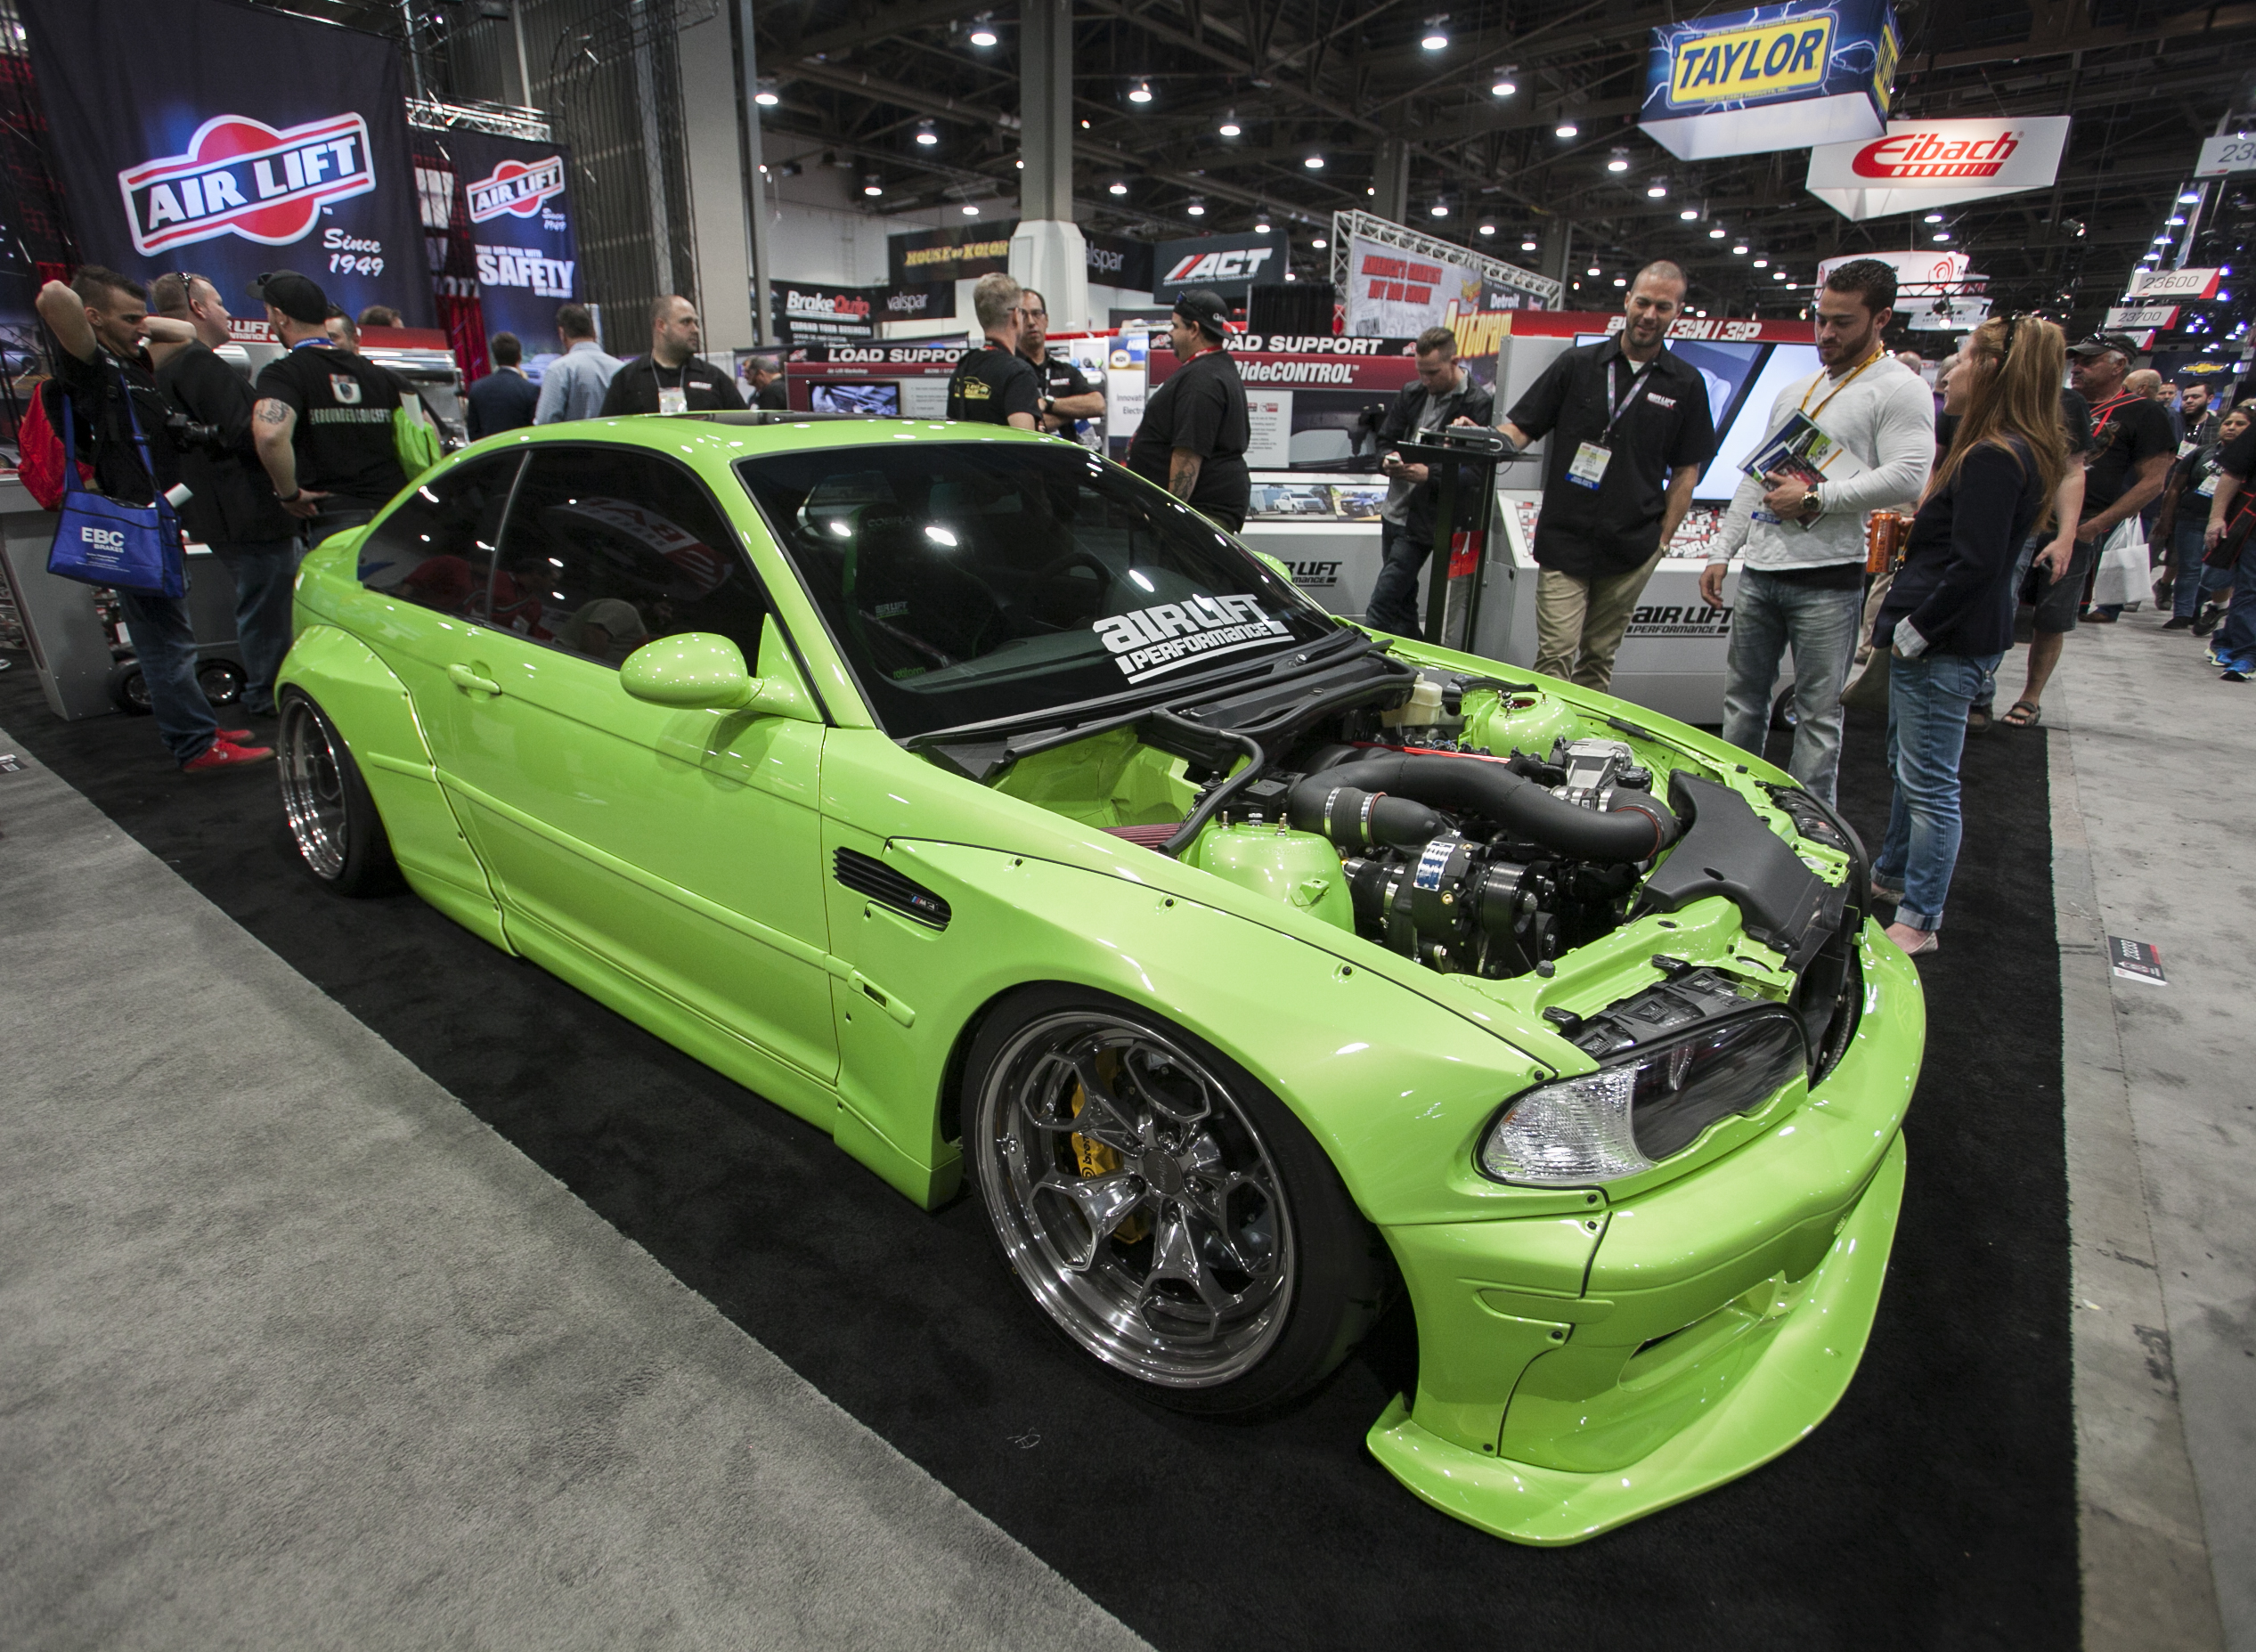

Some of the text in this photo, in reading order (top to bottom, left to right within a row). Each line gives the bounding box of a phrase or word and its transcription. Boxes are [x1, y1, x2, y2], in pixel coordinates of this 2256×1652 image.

[1680, 28, 1824, 88] TAYLOR
[1852, 132, 2018, 178] Eibach
[2218, 142, 2256, 163] 23
[149, 136, 356, 230] AIR LIFT
[476, 167, 558, 212] AIR LIFT
[323, 228, 381, 253] Since
[329, 254, 384, 277] 1949
[904, 246, 951, 266] HOUSE
[1086, 240, 1124, 273] alspar
[1185, 248, 1273, 278] ACT
[476, 254, 575, 289] SAFETY
[2143, 275, 2199, 289] 23600
[787, 290, 870, 321] BrakeQuip
[887, 291, 928, 313] valspar
[1490, 292, 1520, 309] Detroit
[2118, 312, 2162, 322] 23700
[1444, 298, 1512, 359] Autoram
[828, 348, 968, 362] LOAD SUPPO
[1268, 336, 1383, 355] SUPPORT
[81, 526, 125, 547] EBC
[94, 543, 124, 553] BRAKES
[1297, 561, 1342, 575] LIFT
